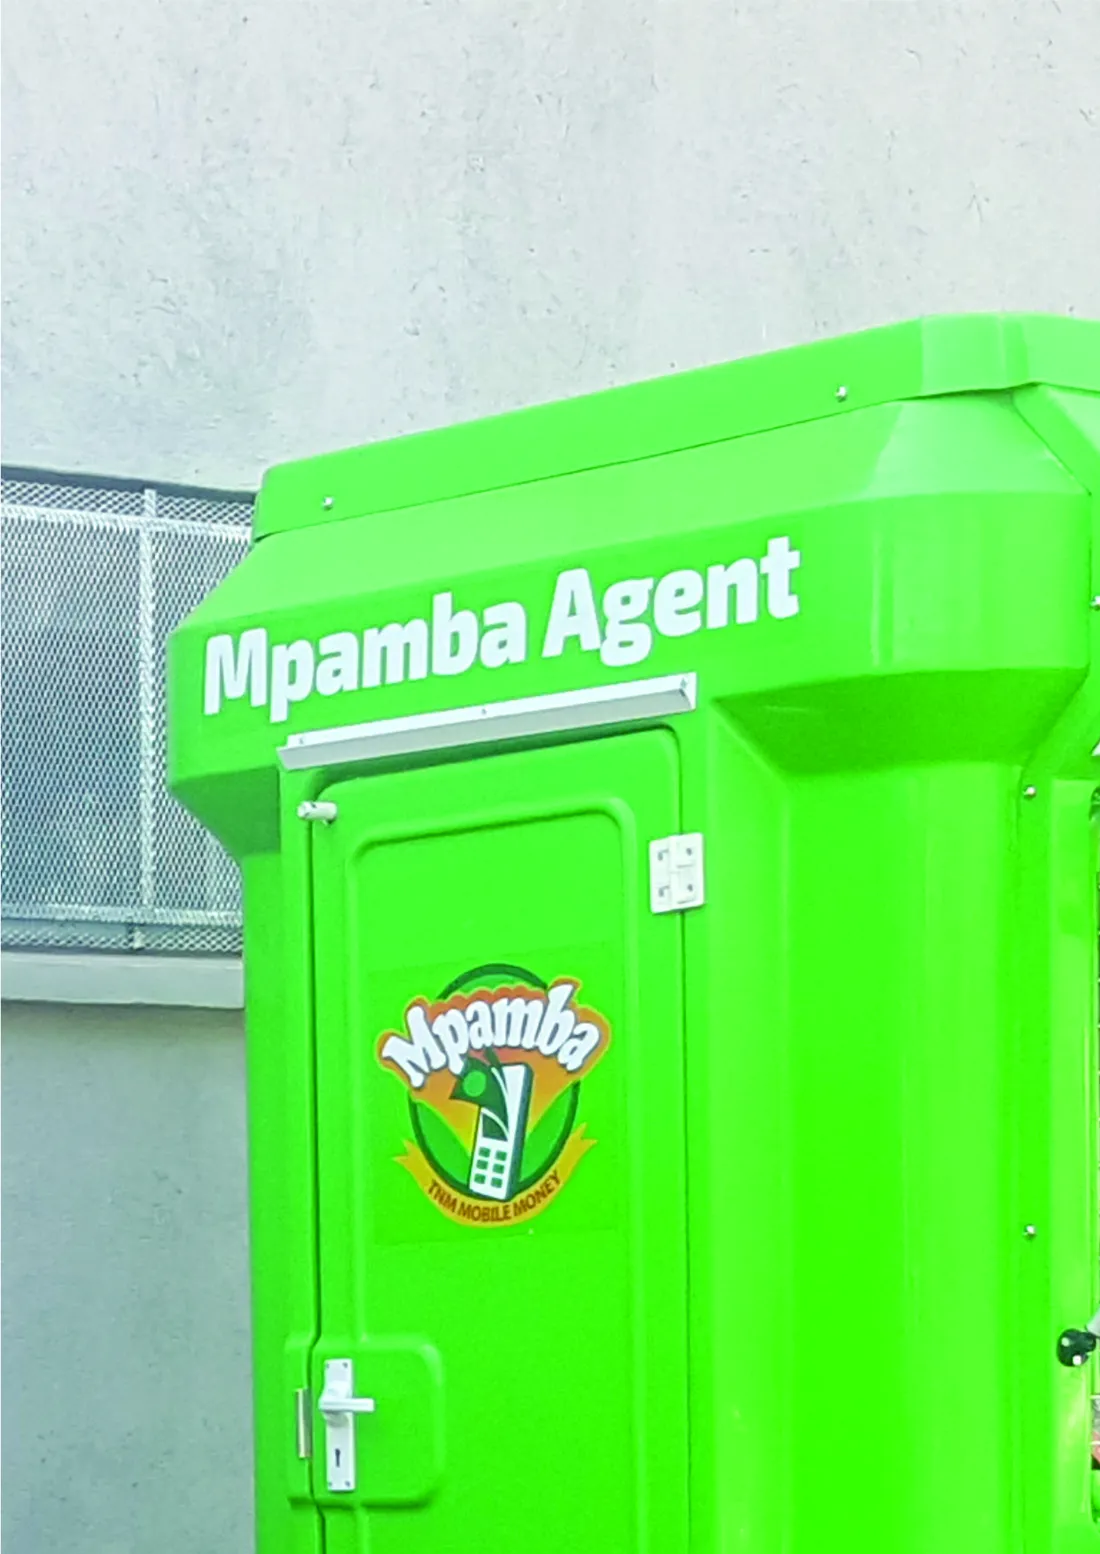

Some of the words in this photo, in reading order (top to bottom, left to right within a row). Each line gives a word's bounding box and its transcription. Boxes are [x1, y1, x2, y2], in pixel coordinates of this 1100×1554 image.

[203, 592, 528, 723] Mpamba
[542, 536, 801, 667] Agent
[382, 983, 601, 1089] Mpamba
[457, 1203, 511, 1222] MOBILE
[513, 1170, 562, 1217] MONEY
